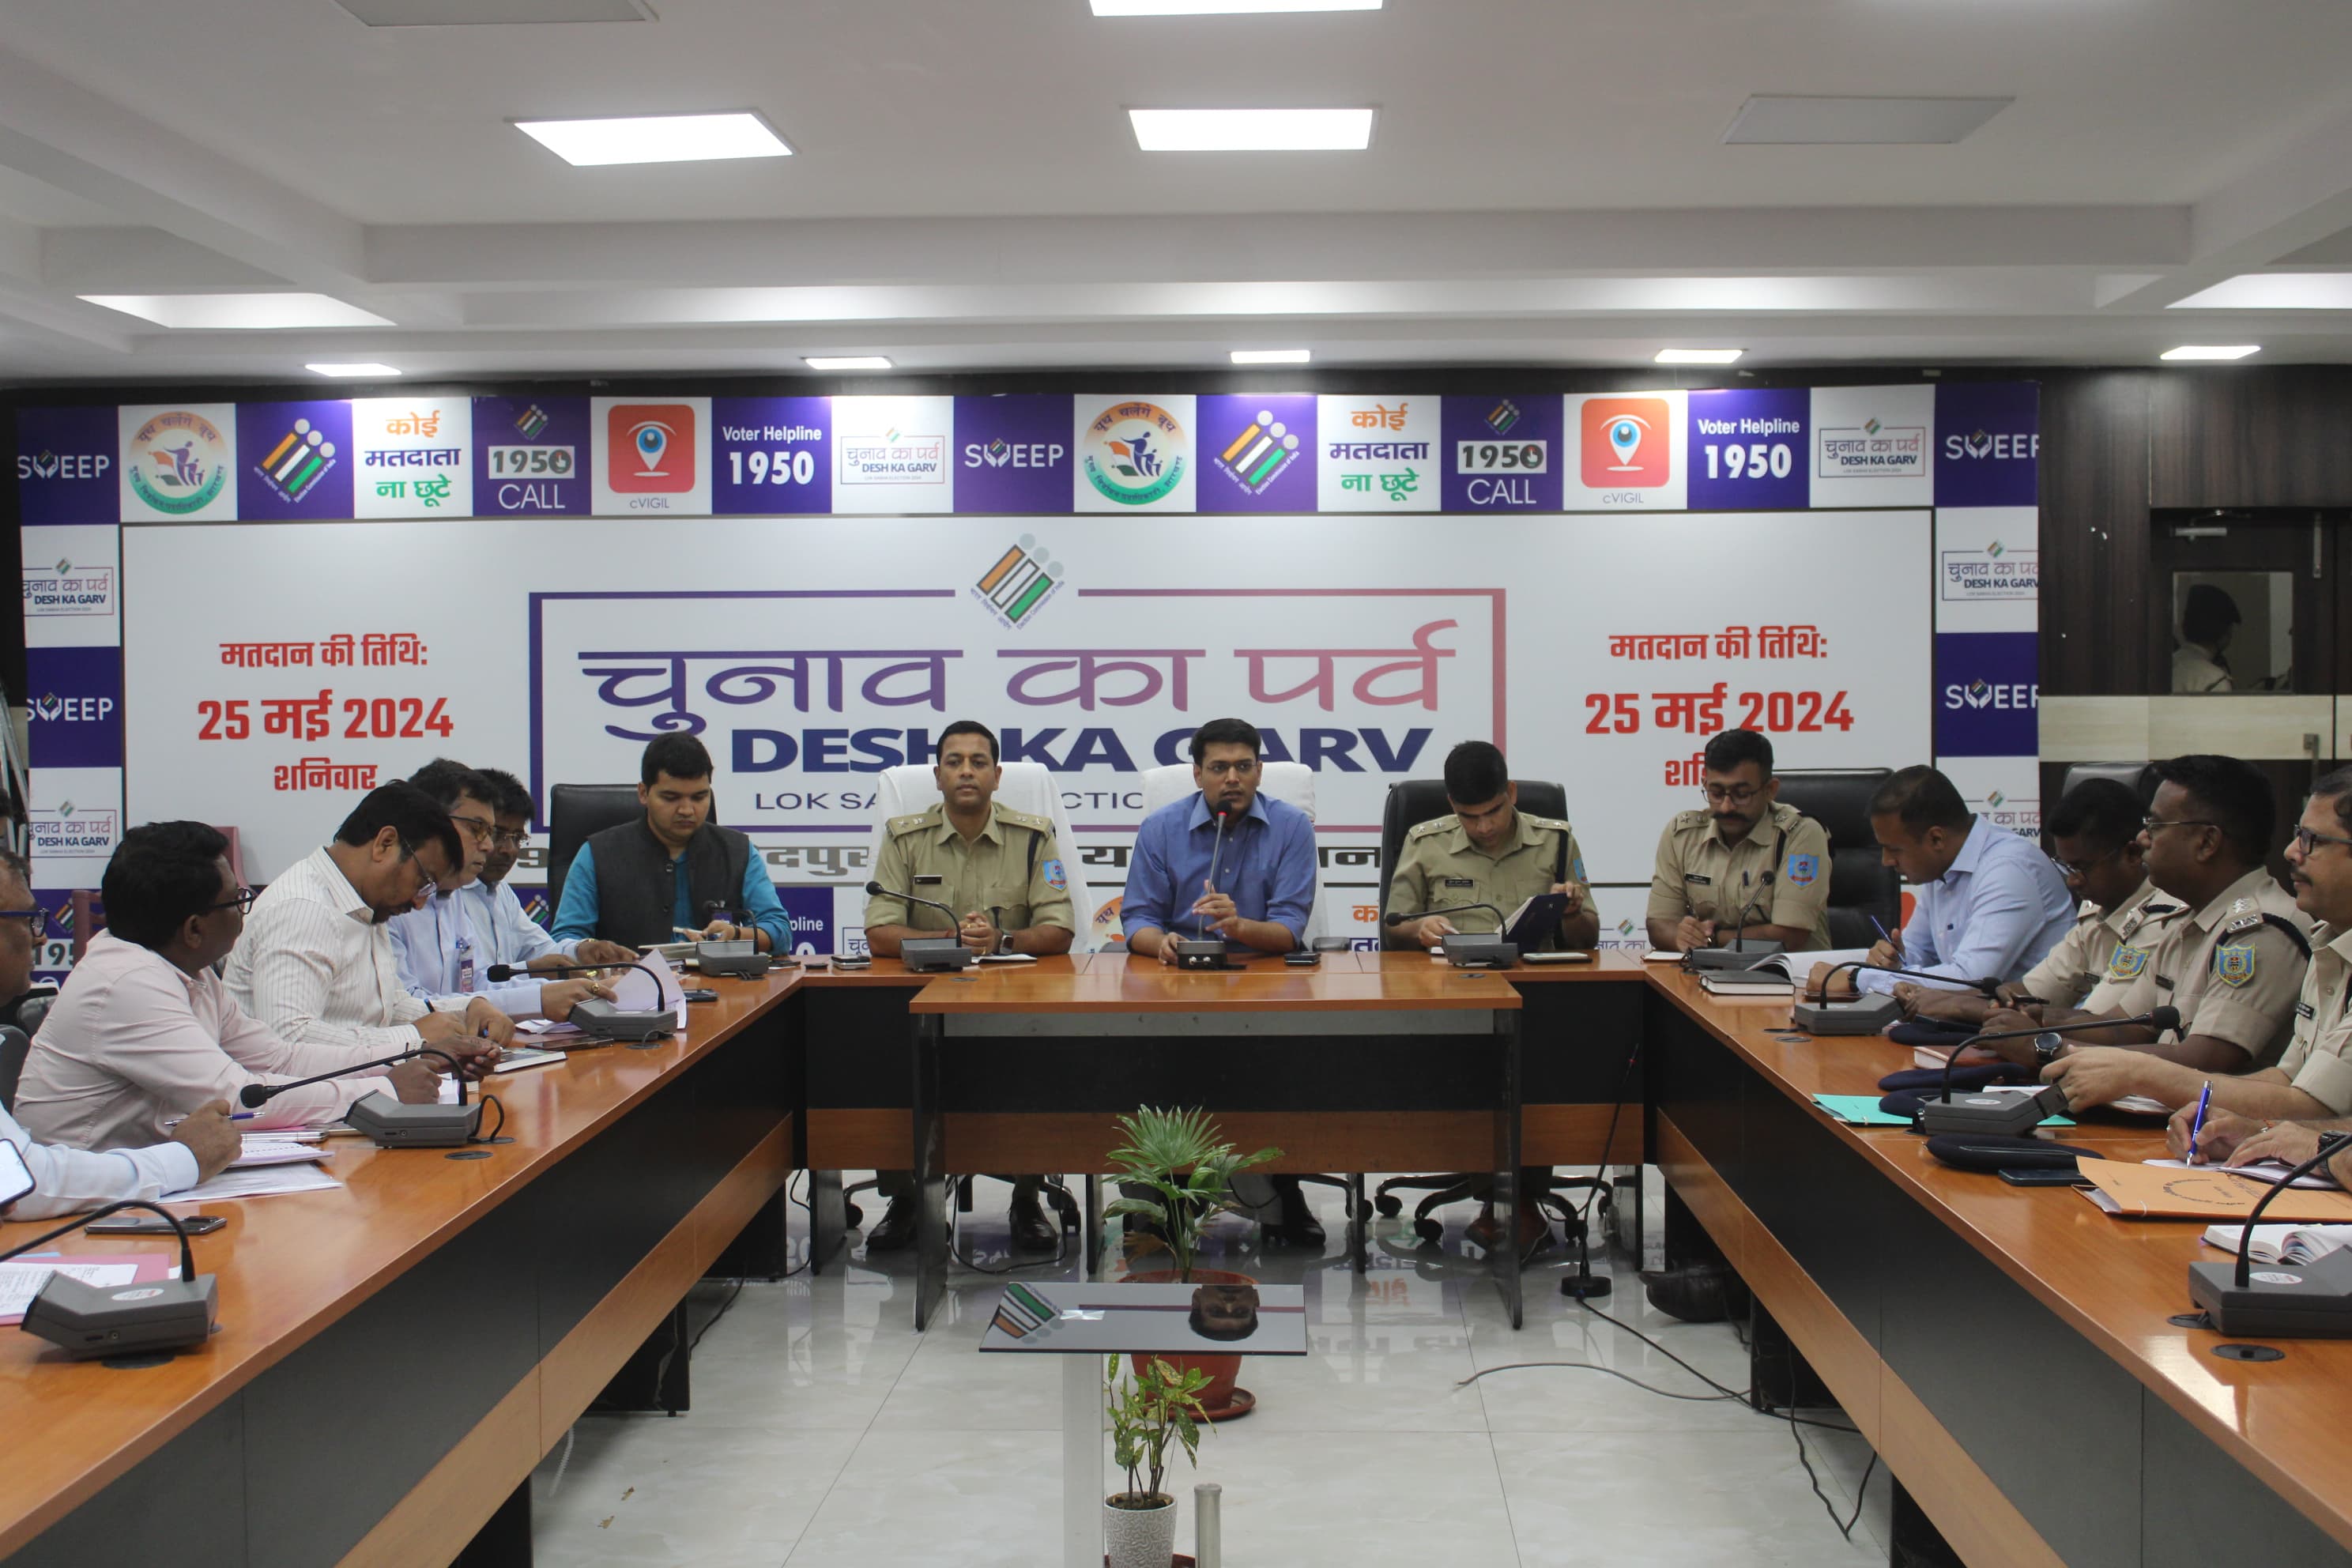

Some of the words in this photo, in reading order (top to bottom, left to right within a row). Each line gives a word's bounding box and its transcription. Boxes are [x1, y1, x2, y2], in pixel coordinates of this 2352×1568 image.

[386, 409, 439, 438] कोई
[1351, 403, 1408, 432] कोई
[1698, 419, 1736, 435] Voter
[1740, 418, 1800, 436] Helpline
[722, 425, 760, 442] Voter
[763, 425, 822, 444] Helpline
[1824, 439, 1867, 459] चुनाव
[1870, 439, 1892, 453] का
[1895, 433, 1920, 452] पर्व
[364, 448, 462, 467] मतदाता
[492, 450, 572, 474] 1950
[846, 447, 887, 466] चुनाव
[891, 447, 912, 461] का
[964, 443, 1064, 468] SWEEP
[1329, 442, 1430, 461] मतदाता
[1462, 445, 1544, 469] 1950
[1704, 444, 1792, 479] 1950
[1841, 456, 1868, 466] DESH
[1870, 455, 1886, 465] KA
[1887, 455, 1917, 465] GARV
[17, 454, 110, 479] SWEEP
[729, 450, 815, 485] 1950
[862, 463, 888, 473] DESH
[891, 463, 906, 473] KA
[907, 463, 937, 473] GARV
[375, 480, 405, 499] ना
[414, 474, 453, 507] छूटे
[1340, 473, 1372, 492] ना
[1380, 467, 1420, 501] छूटे
[1467, 479, 1536, 505] CALL
[498, 483, 566, 510] CALL
[629, 497, 670, 509] cVIGIL
[1603, 492, 1644, 504] cVIGIL
[1947, 563, 1989, 582] चुनाव
[1994, 563, 2016, 575] का
[1964, 579, 1991, 589] DESH
[1993, 579, 2009, 588] KA
[62, 579, 83, 592] का
[35, 595, 60, 605] DESH
[62, 594, 76, 604] KA
[77, 594, 106, 604] GARV
[220, 643, 314, 668] मतदान
[321, 635, 356, 665] की
[362, 634, 428, 665] तिथि:
[1609, 635, 1709, 660] मतदान
[1715, 626, 1750, 658] की
[1758, 625, 1827, 658] तिथि:
[579, 650, 963, 741] चुनाव
[997, 649, 1206, 711] का
[1234, 619, 1459, 711] पर्व
[198, 700, 250, 741] 25
[261, 689, 333, 741] मई
[344, 698, 454, 738] 2024
[1585, 694, 1640, 734] 25
[1652, 683, 1728, 736] मई
[1740, 691, 1854, 732] 2024
[1001, 729, 1137, 772] KA
[273, 758, 378, 790] शनिवार
[756, 793, 830, 810] LOK
[65, 821, 85, 835] का
[38, 837, 64, 846] DESH
[66, 837, 79, 846] KA
[81, 837, 109, 846] GARV
